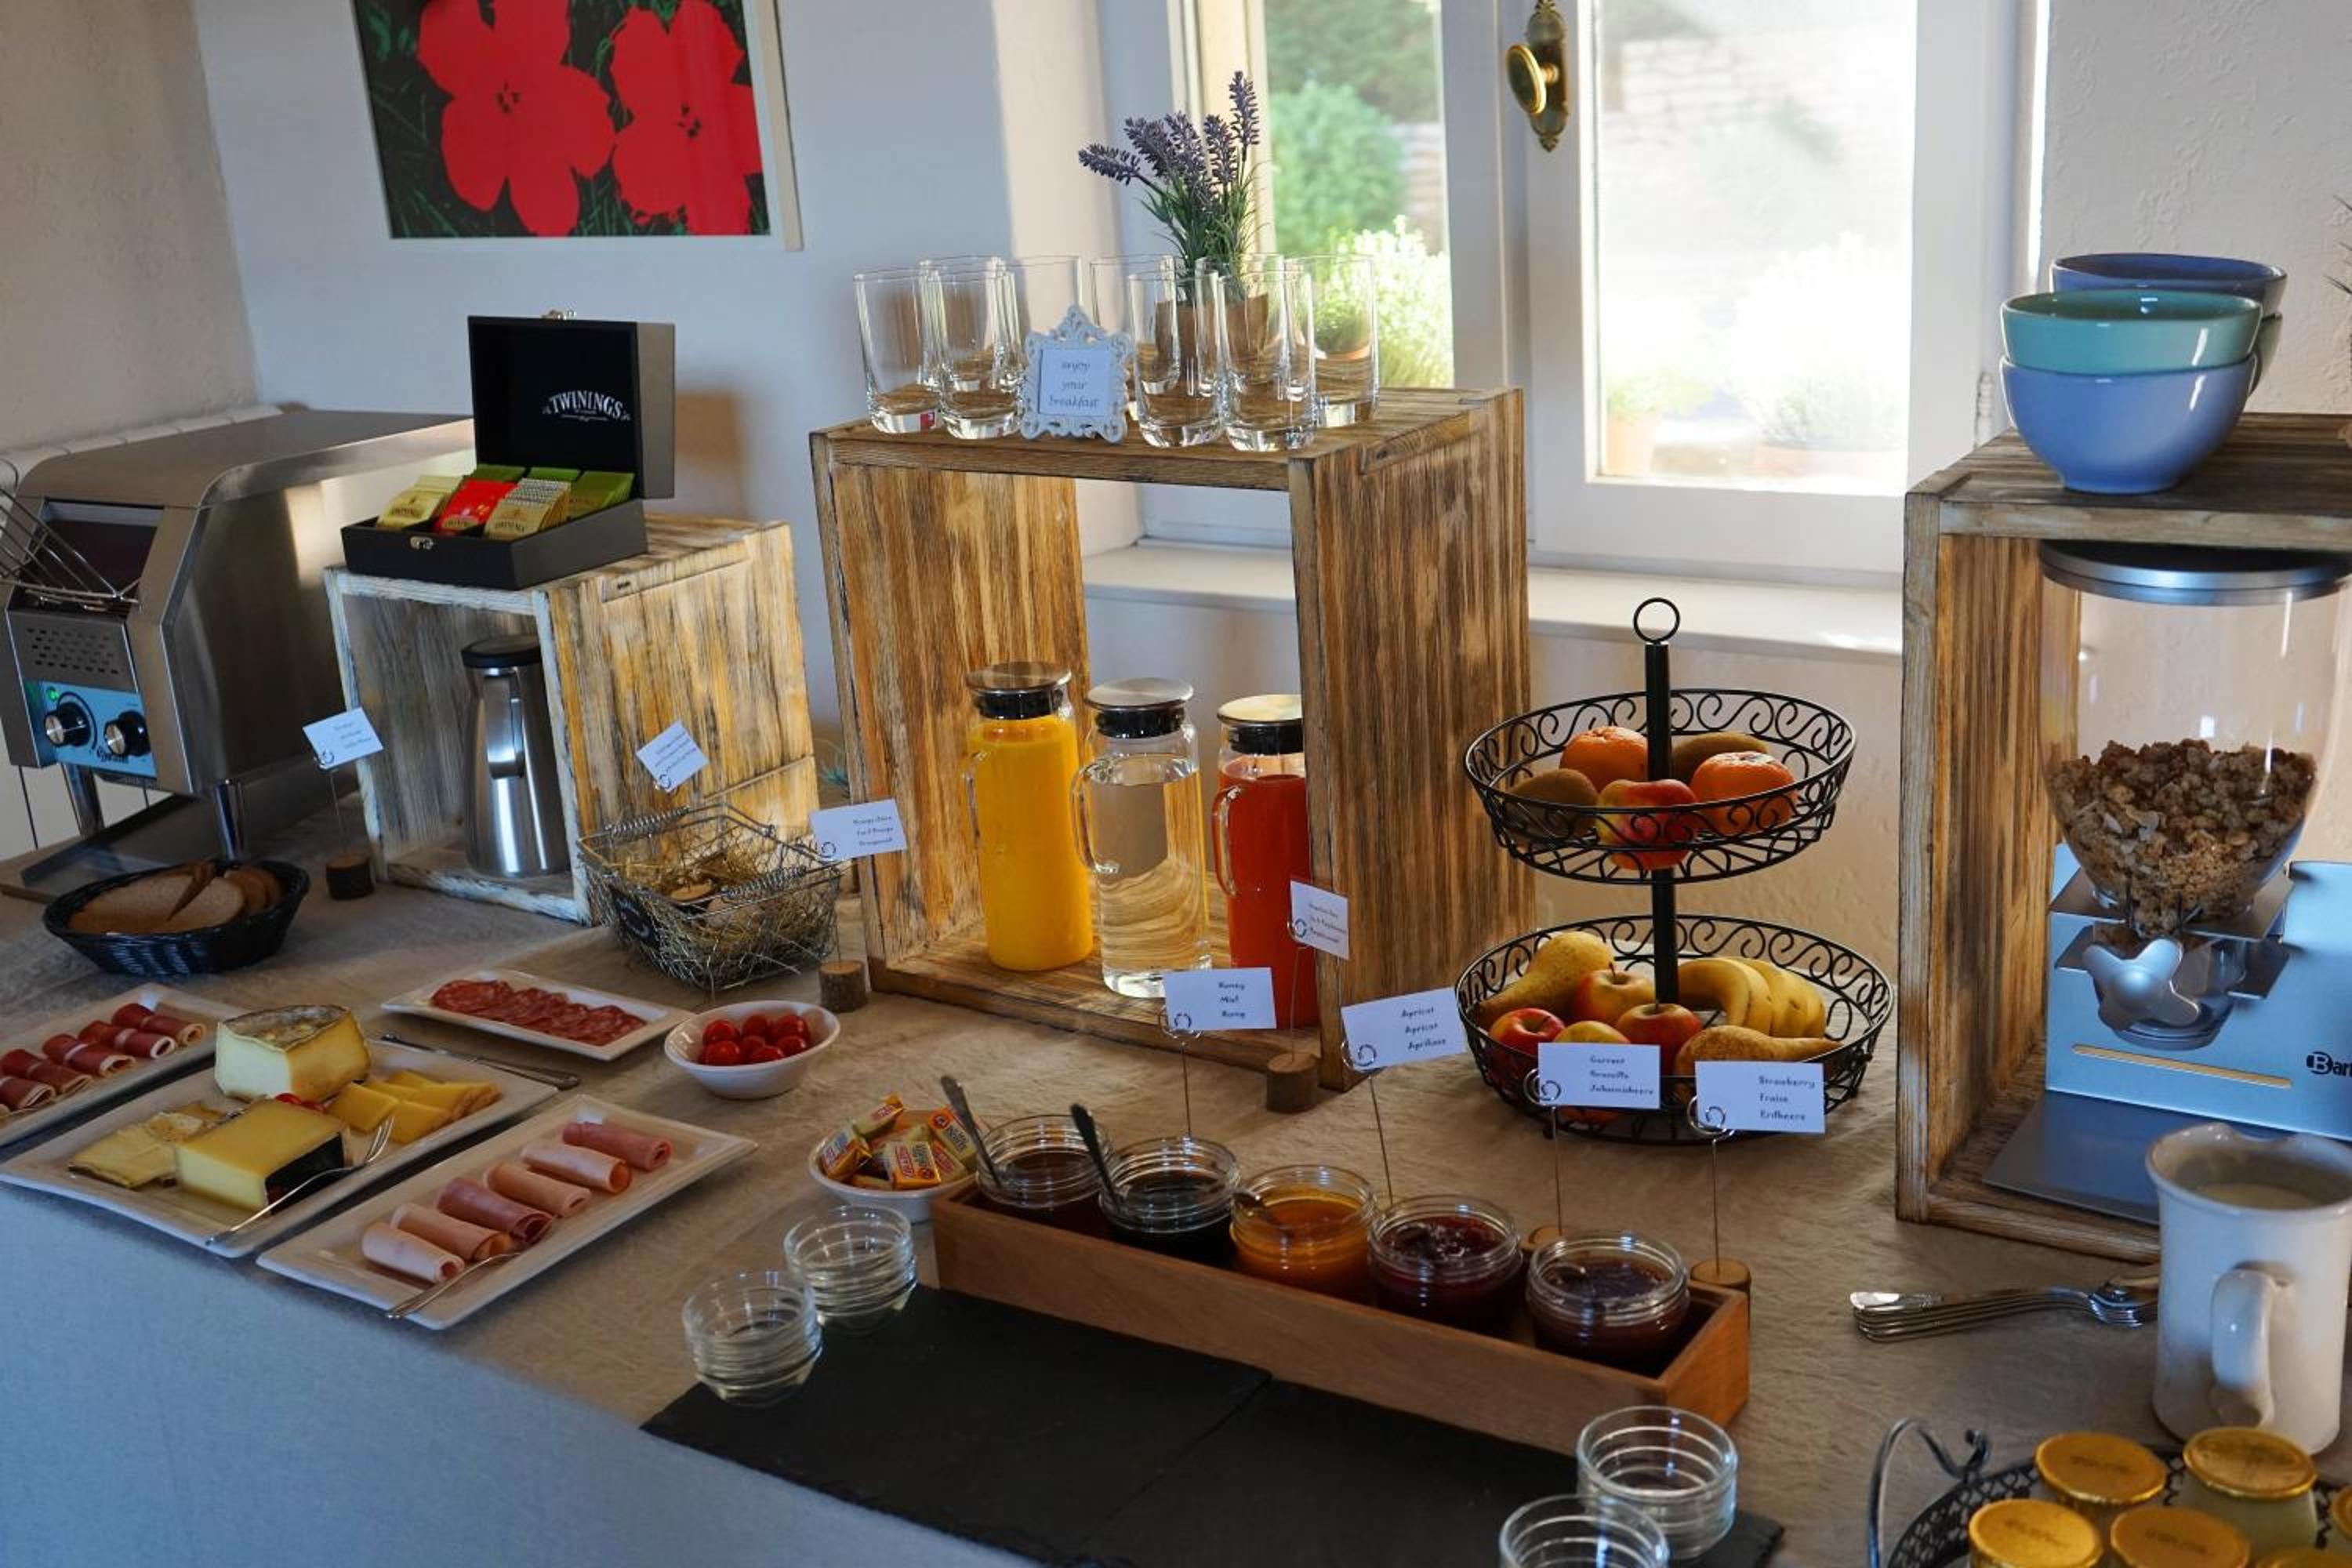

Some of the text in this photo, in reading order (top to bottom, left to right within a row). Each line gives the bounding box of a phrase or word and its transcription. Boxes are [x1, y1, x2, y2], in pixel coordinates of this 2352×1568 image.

[1061, 362, 1091, 373] enjoy
[1061, 381, 1088, 392] your
[550, 390, 623, 419] TWININGS
[1048, 394, 1100, 410] breakfast
[1401, 1007, 1435, 1019] Apricot
[1759, 1075, 1816, 1089] Strawberry
[1760, 1093, 1788, 1102] Fraise
[1760, 1109, 1806, 1121] Erdbeere
